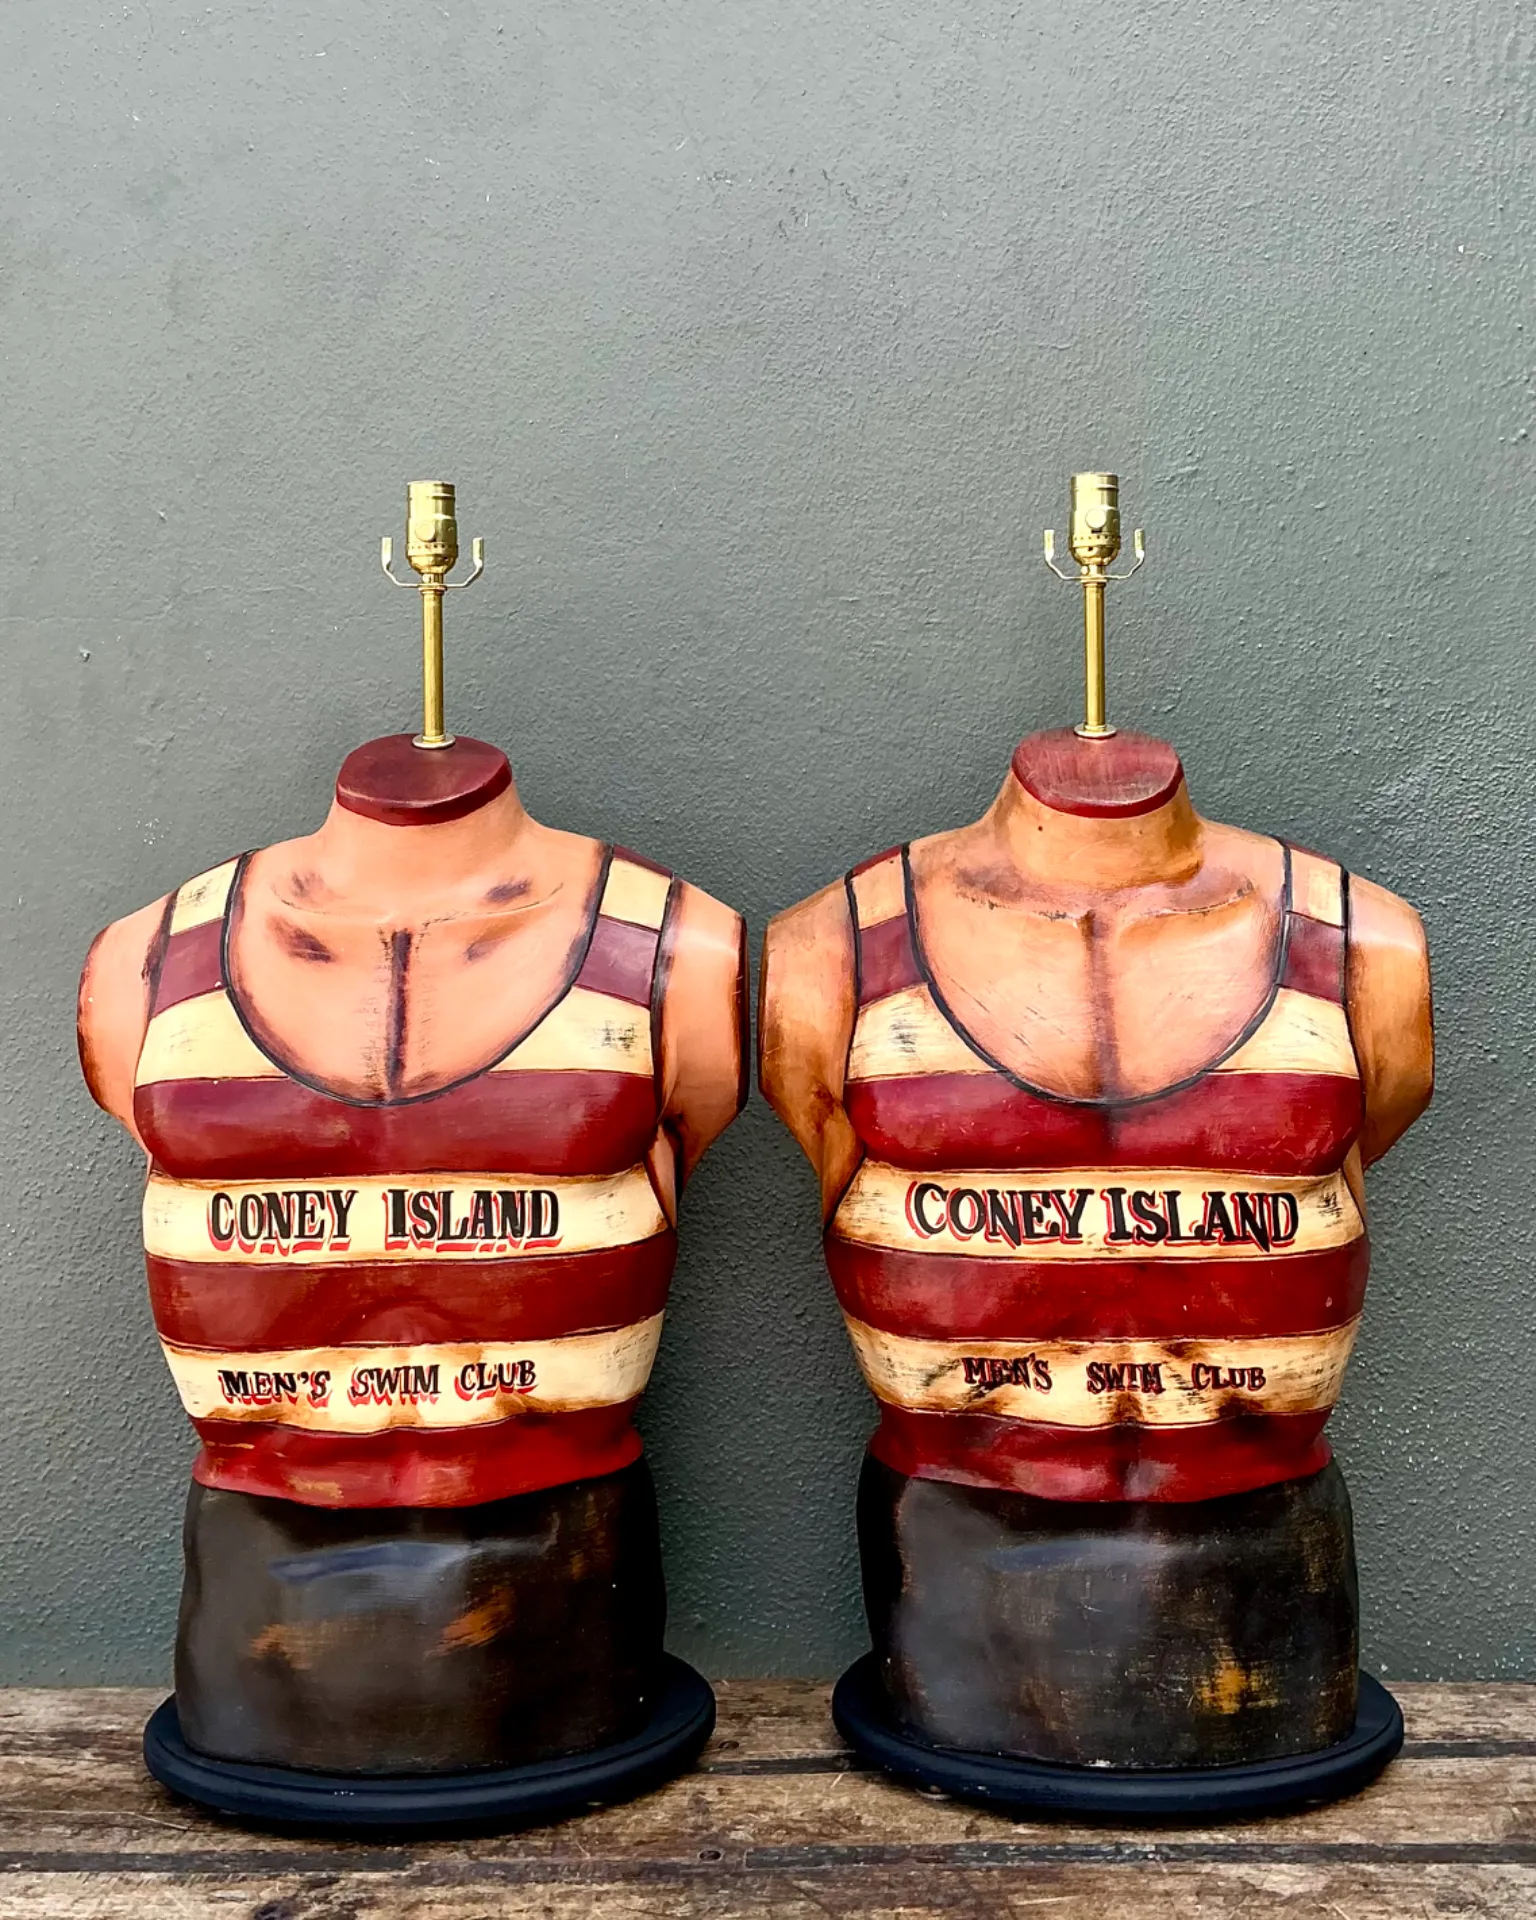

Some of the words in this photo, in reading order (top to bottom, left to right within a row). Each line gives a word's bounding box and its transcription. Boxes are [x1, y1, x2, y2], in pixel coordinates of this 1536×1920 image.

[208, 1189, 358, 1253] CONEY
[383, 1188, 563, 1252] ISLAND
[905, 1182, 1094, 1248] CONEY
[1101, 1187, 1299, 1252] ISLAND
[218, 1369, 332, 1407] MEN'S
[348, 1364, 442, 1405] SWIM
[454, 1360, 538, 1400] CLUB
[961, 1352, 1053, 1393] MEN'S
[1086, 1360, 1164, 1394] SWIM
[1191, 1363, 1266, 1391] CLUB
